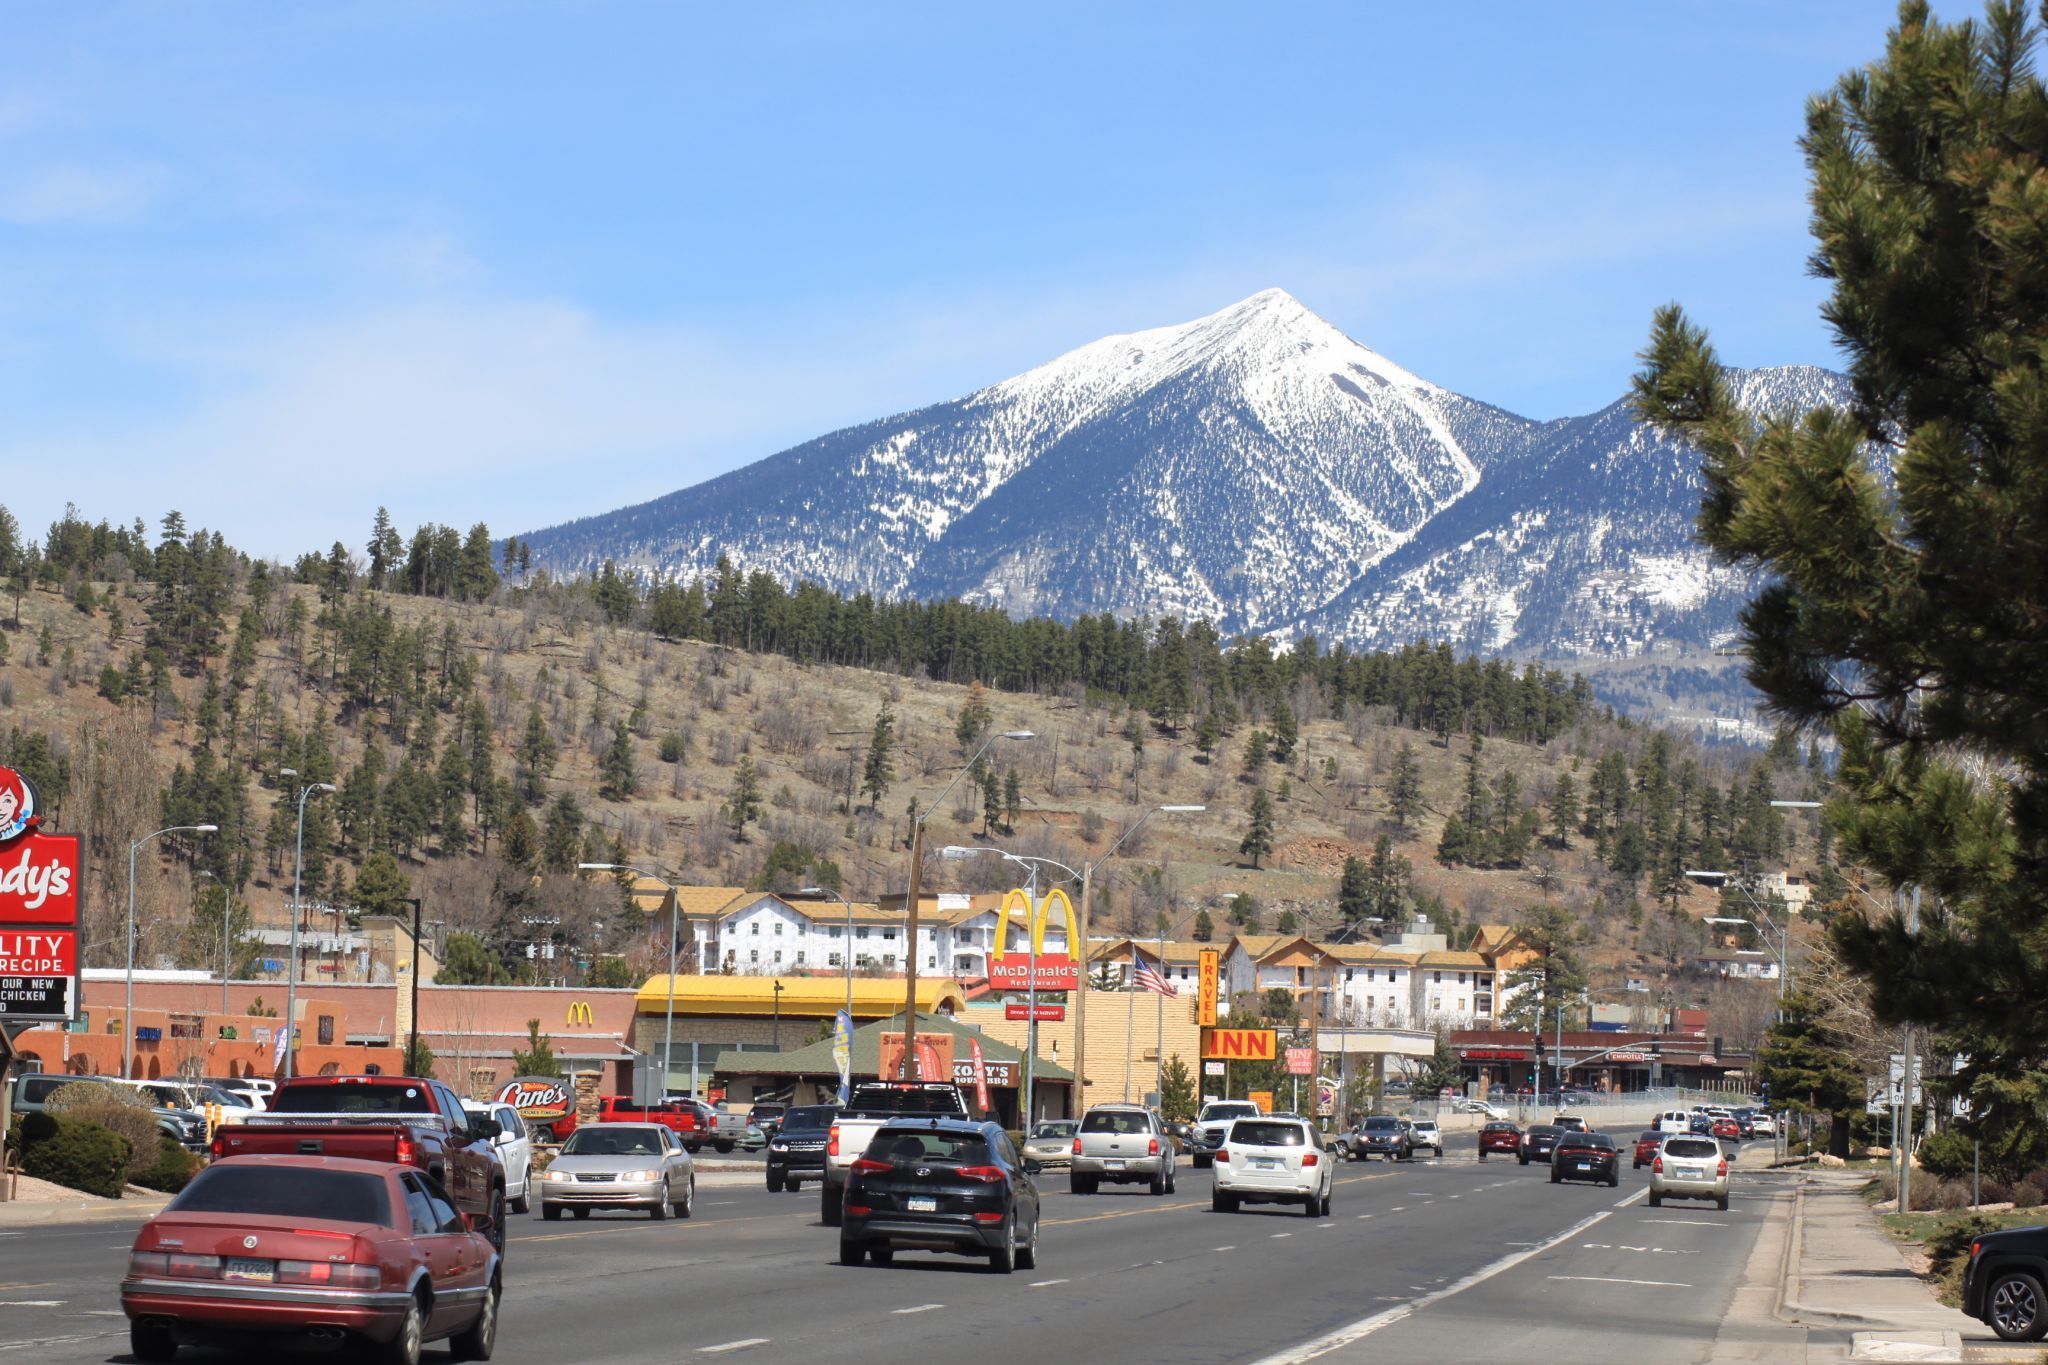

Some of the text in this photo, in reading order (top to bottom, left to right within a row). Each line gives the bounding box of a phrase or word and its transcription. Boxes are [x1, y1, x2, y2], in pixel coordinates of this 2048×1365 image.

[0, 848, 70, 909] dy's
[1, 991, 46, 1001] CHICKEN
[2, 979, 23, 989] OUR
[1204, 952, 1214, 1023] TRAVEL
[1210, 1031, 1268, 1057] INN
[987, 1077, 1009, 1086] BBQ
[499, 1082, 567, 1109] Cane's
